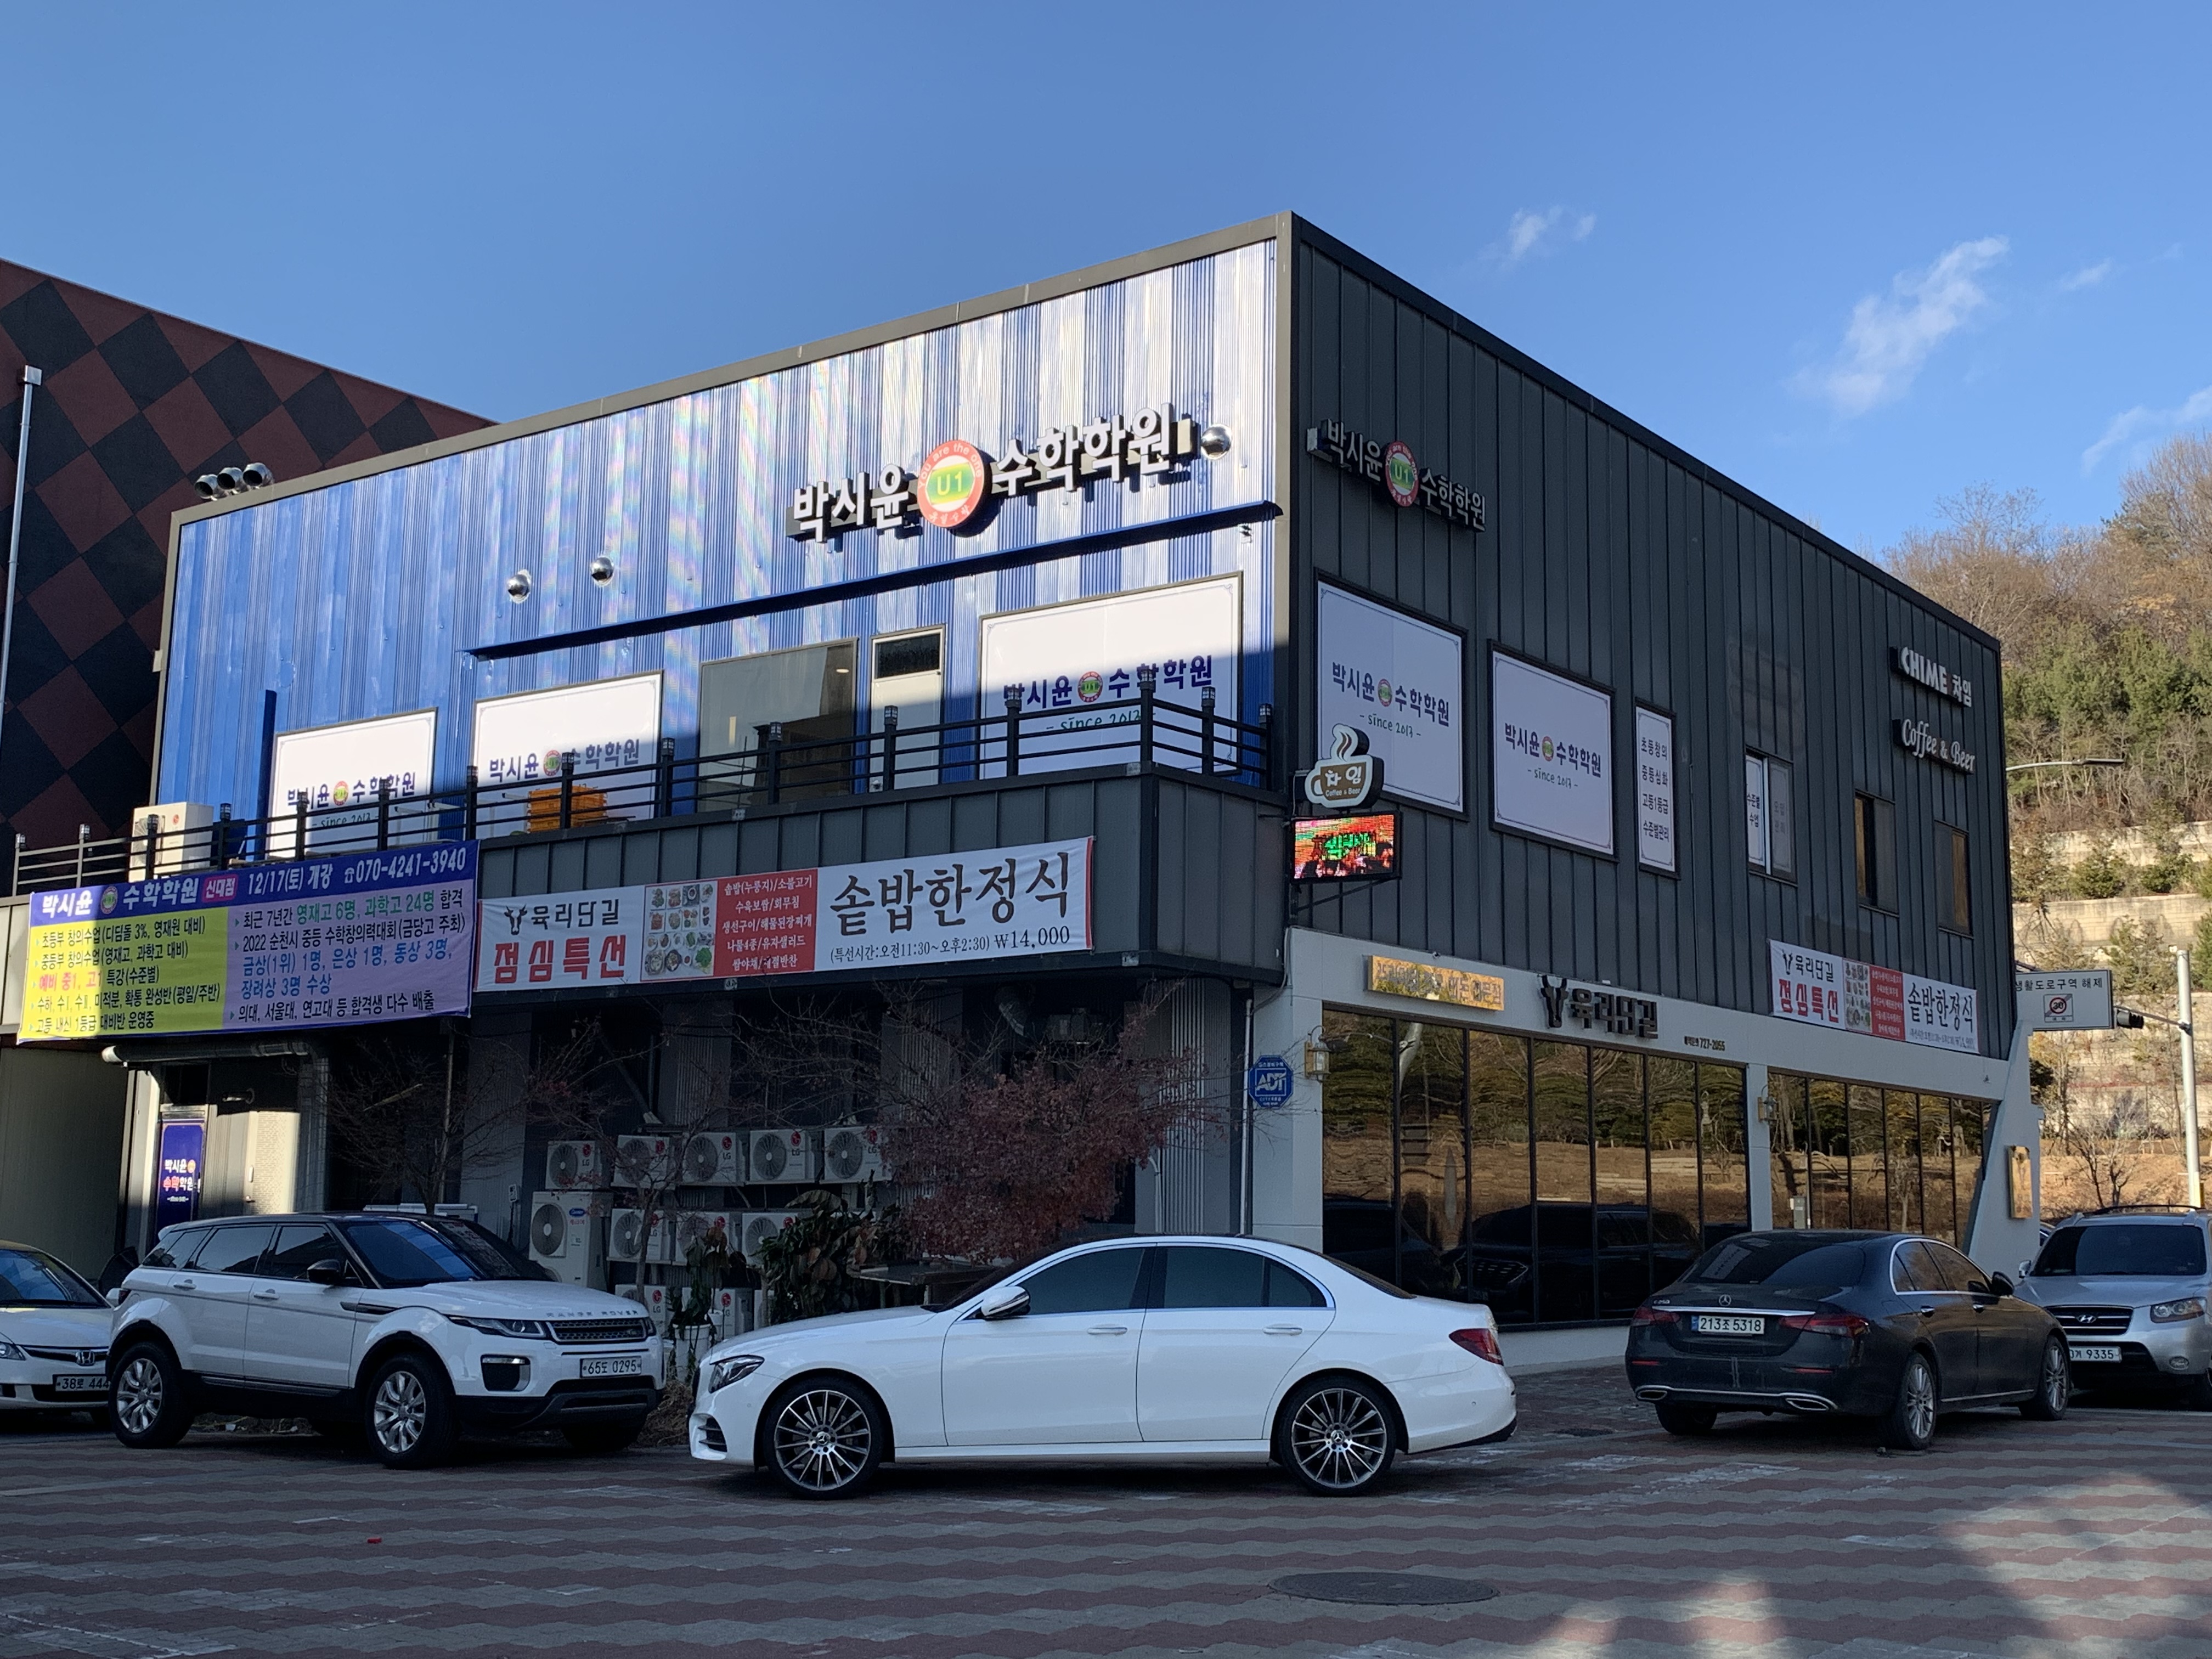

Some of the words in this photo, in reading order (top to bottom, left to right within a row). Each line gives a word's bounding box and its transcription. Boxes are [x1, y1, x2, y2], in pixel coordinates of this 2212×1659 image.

[793, 463, 909, 543] 박시윤
[937, 471, 962, 495] U1
[996, 403, 1175, 496] 수학학원
[1328, 419, 1383, 482] 박시윤
[1395, 464, 1408, 483] U1
[1421, 469, 1485, 532] 수학학원
[1901, 647, 1948, 695] CHIME
[1953, 674, 1972, 708] 차임
[1333, 662, 1374, 702] 박시윤
[1395, 685, 1448, 727] 수학학원
[1368, 714, 1392, 731] since
[1396, 723, 1413, 738] 2013
[1505, 723, 1539, 758] 박시윤
[1556, 742, 1601, 778] 수학학원
[1902, 719, 1937, 758] Coffee
[1940, 740, 1948, 759] &
[1951, 741, 1975, 771] Beer
[490, 753, 539, 783] 박시윤
[1534, 768, 1555, 783] since
[42, 890, 93, 918] 박시윤
[123, 878, 199, 910] 수학학원
[206, 877, 235, 900] 신대점
[249, 866, 303, 895] 12/17(토)
[308, 864, 333, 890] 개강
[356, 847, 466, 883] 070-4241-3940
[830, 852, 1068, 935] 솥밥한정식
[244, 911, 263, 929] 최근
[267, 909, 292, 927] 7년간
[297, 903, 331, 924] 영재고
[336, 900, 360, 920] 6명,
[365, 896, 402, 918] 과학고
[406, 890, 435, 912] 24명
[441, 888, 463, 909] 합격
[532, 899, 618, 929] 육리단길
[42, 932, 64, 948] 초등부
[155, 918, 180, 938] 영재원
[184, 916, 205, 935] 대비)
[244, 936, 266, 952] 2022
[269, 934, 298, 951] 순천시
[302, 930, 321, 949] 중등
[439, 912, 466, 933] 주최)
[42, 952, 64, 970] 중등부
[138, 943, 163, 961] 과학고
[167, 940, 188, 960] 대비)
[243, 953, 296, 977] 금상(1위)
[303, 950, 325, 972] 1명,
[332, 947, 357, 969] 은상
[364, 944, 387, 967] 1명,
[395, 941, 420, 963] 동상
[426, 938, 452, 960] 3명,
[495, 935, 625, 983] 점심특선
[1796, 955, 1834, 983] 육리단길
[39, 973, 57, 992] 예비
[107, 965, 159, 986] 특강(수준별)
[241, 979, 275, 1000] 장려상
[281, 975, 301, 996] 3명
[307, 973, 331, 995] 수상
[2016, 979, 2077, 991] 생활도로구역
[303, 999, 332, 1019] 연고대
[337, 997, 347, 1017] 등
[352, 995, 382, 1016] 합격생
[387, 992, 408, 1013] 다수
[413, 990, 435, 1011] 배출
[1570, 989, 1658, 1039] 육리단길
[1779, 979, 1838, 1023] 점심특선
[1908, 982, 1973, 1033] 솥밥한정식
[36, 1018, 52, 1034] 고등
[100, 1012, 126, 1030] 대비반
[129, 1011, 154, 1029] 운영중
[1256, 1073, 1286, 1091] ADT
[1700, 1318, 1729, 1330] 213조
[1733, 1319, 1761, 1331] 5318
[612, 1360, 636, 1372] 0295
[2086, 1350, 2114, 1359] 9335
